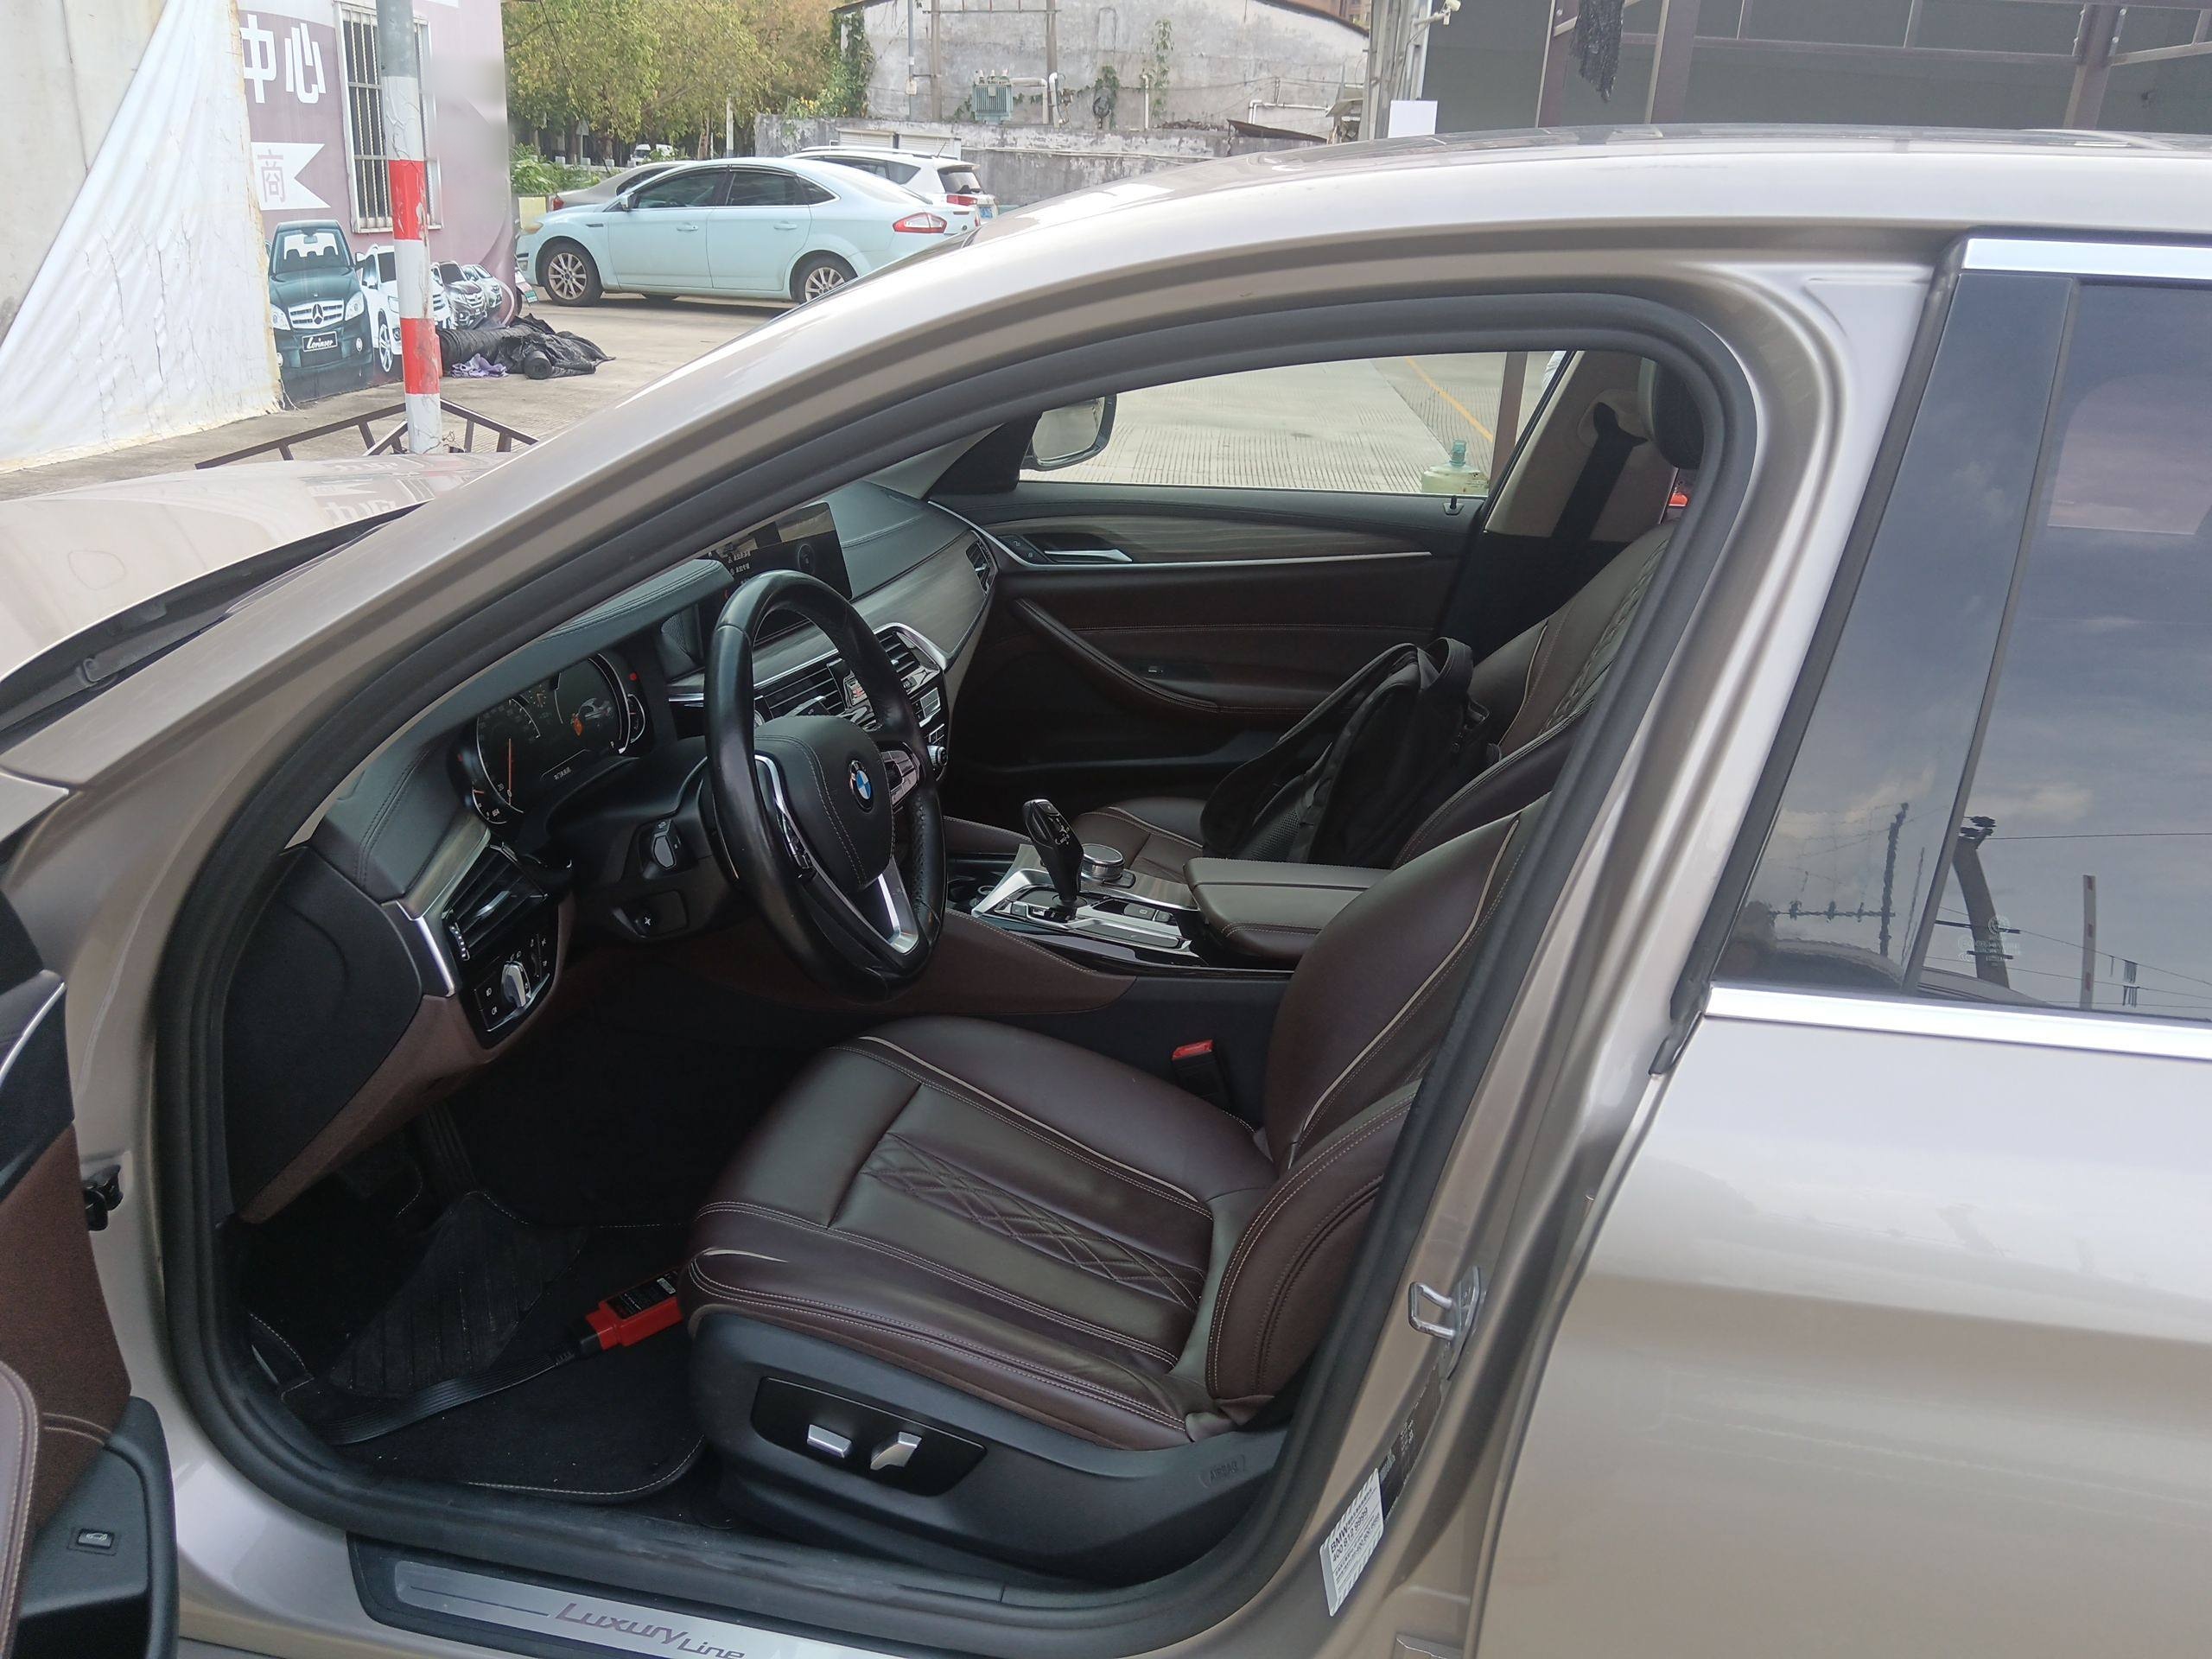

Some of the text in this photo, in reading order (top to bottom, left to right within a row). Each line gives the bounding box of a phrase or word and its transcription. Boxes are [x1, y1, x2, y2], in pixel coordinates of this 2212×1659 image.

[240, 13, 327, 104] 中心
[257, 149, 286, 203] 商
[1331, 1523, 1348, 1553] BMW
[555, 1603, 746, 1659] Luxury Line
